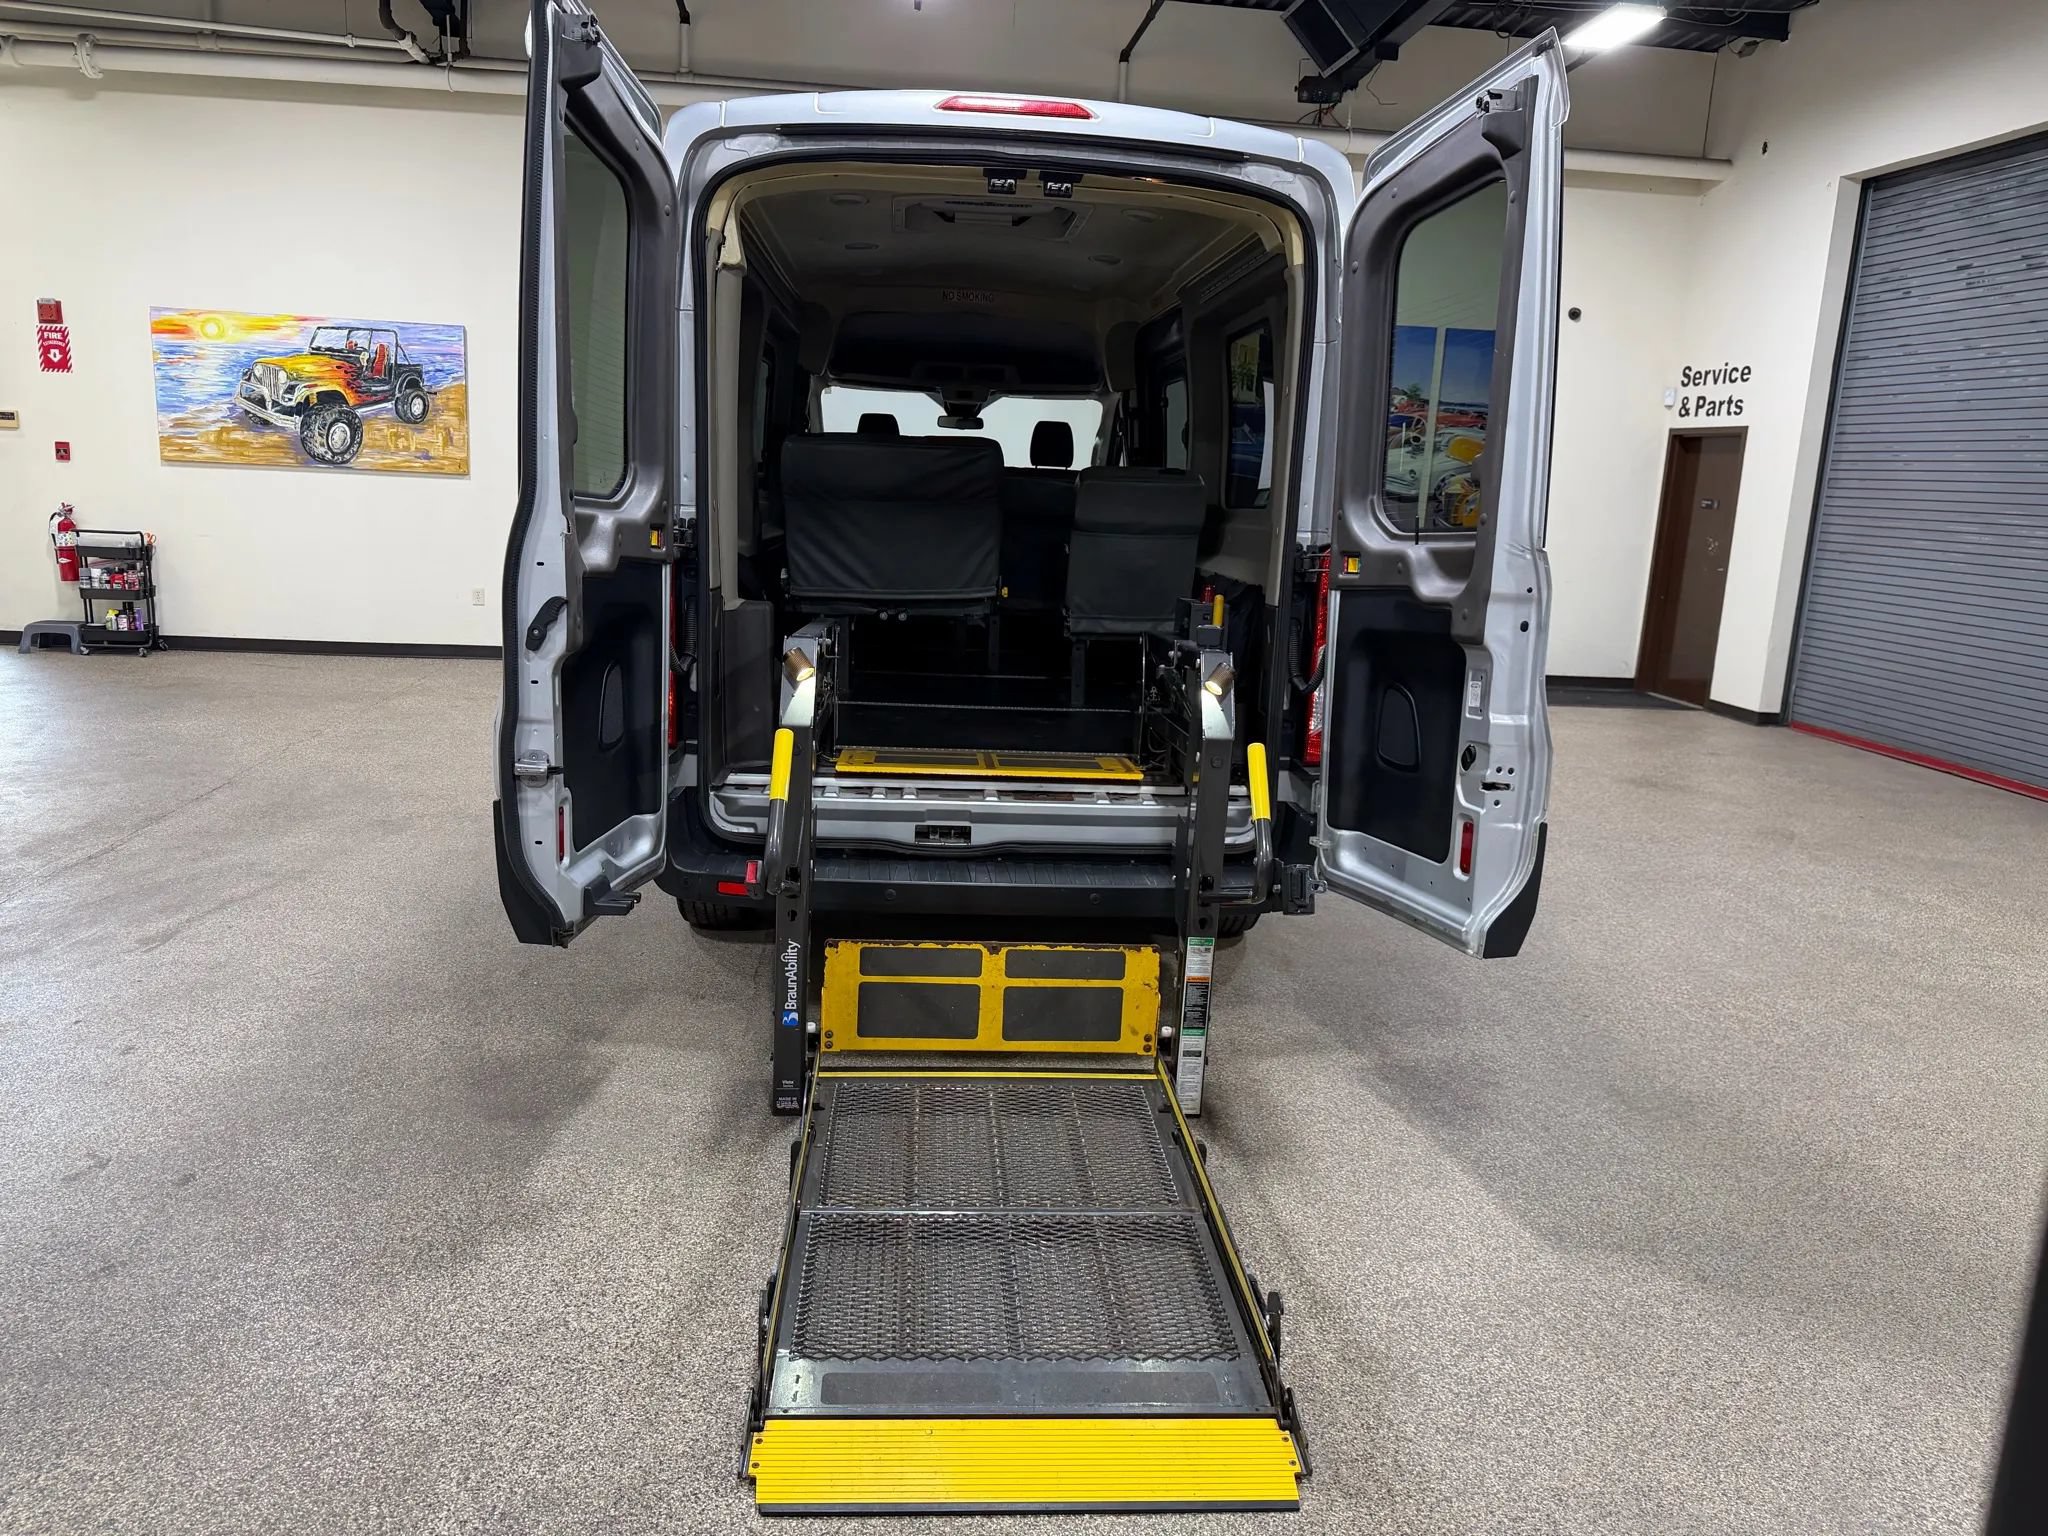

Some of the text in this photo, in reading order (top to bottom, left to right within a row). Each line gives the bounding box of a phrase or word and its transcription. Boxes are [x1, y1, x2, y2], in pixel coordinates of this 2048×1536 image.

[943, 290, 994, 303] NO SMOKING
[43, 332, 63, 340] FIRE
[1681, 362, 1751, 387] Service
[1679, 394, 1744, 417] & Parts
[780, 940, 801, 1009] BraunAbility
